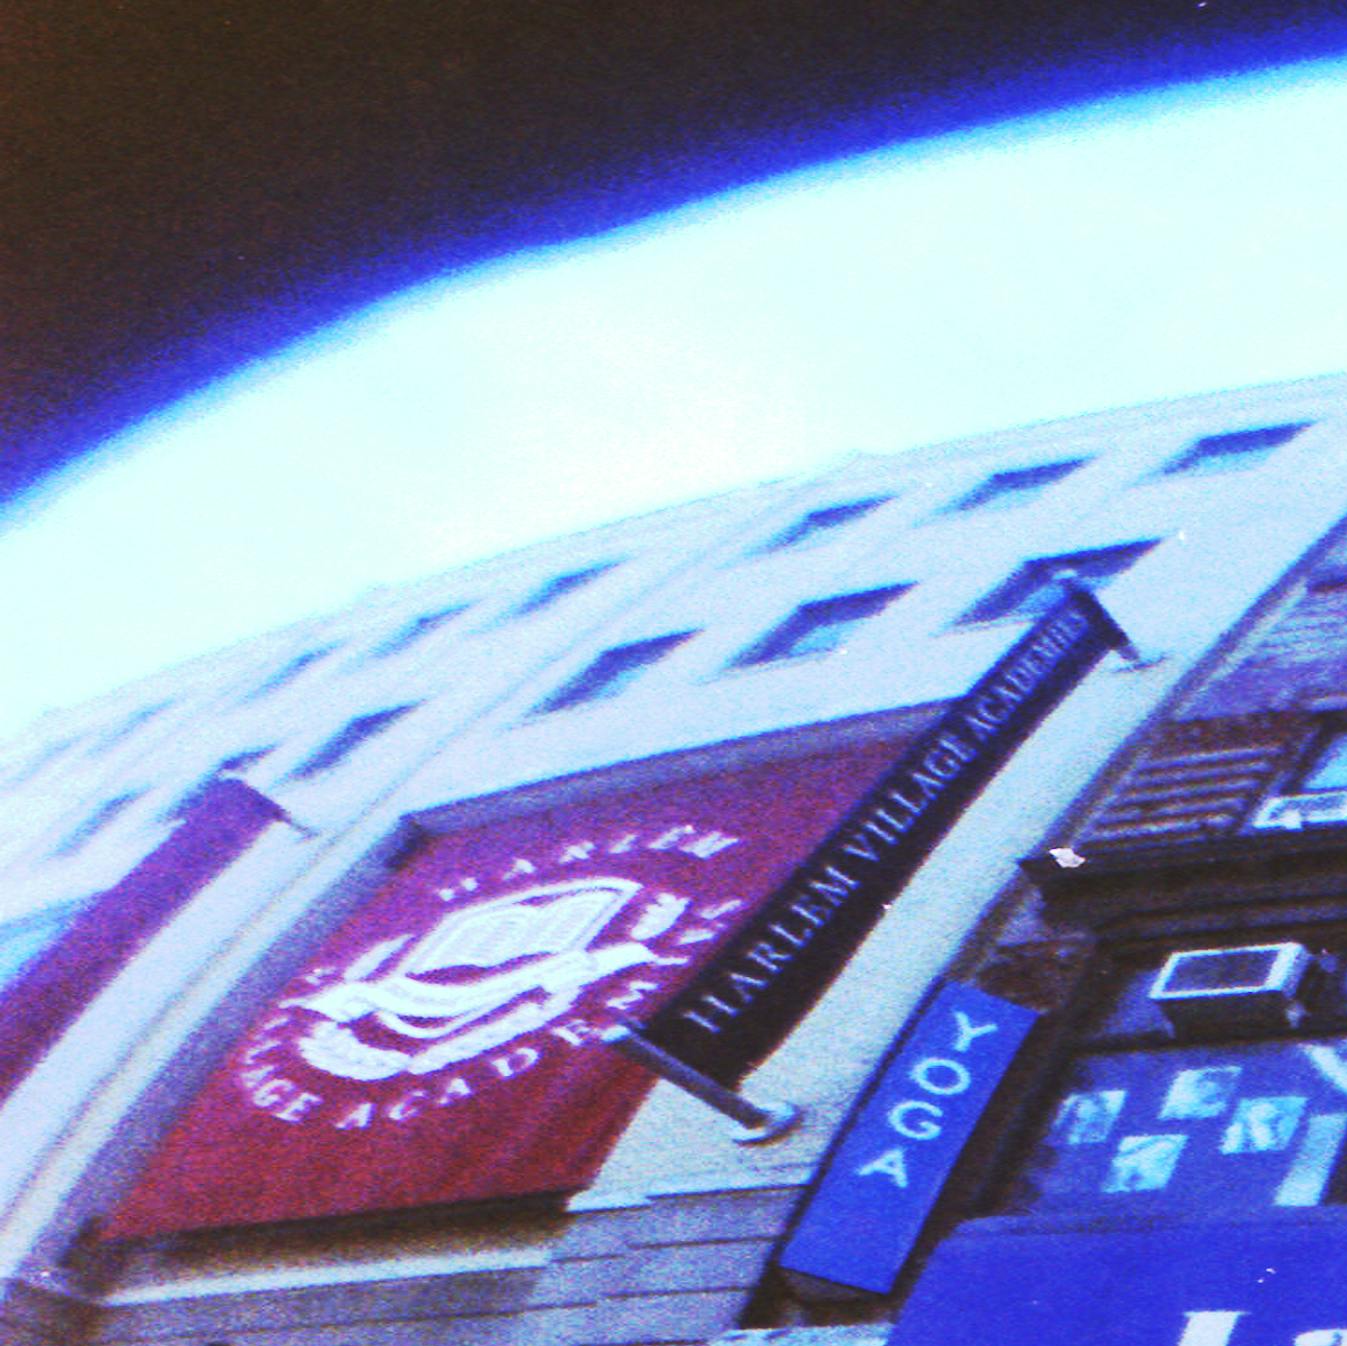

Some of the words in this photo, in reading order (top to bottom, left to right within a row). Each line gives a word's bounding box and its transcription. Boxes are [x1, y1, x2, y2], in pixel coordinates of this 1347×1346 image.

[682, 865, 862, 1035] HARLEM
[844, 737, 977, 863] VILLAGE
[857, 1011, 998, 1187] YOGA
